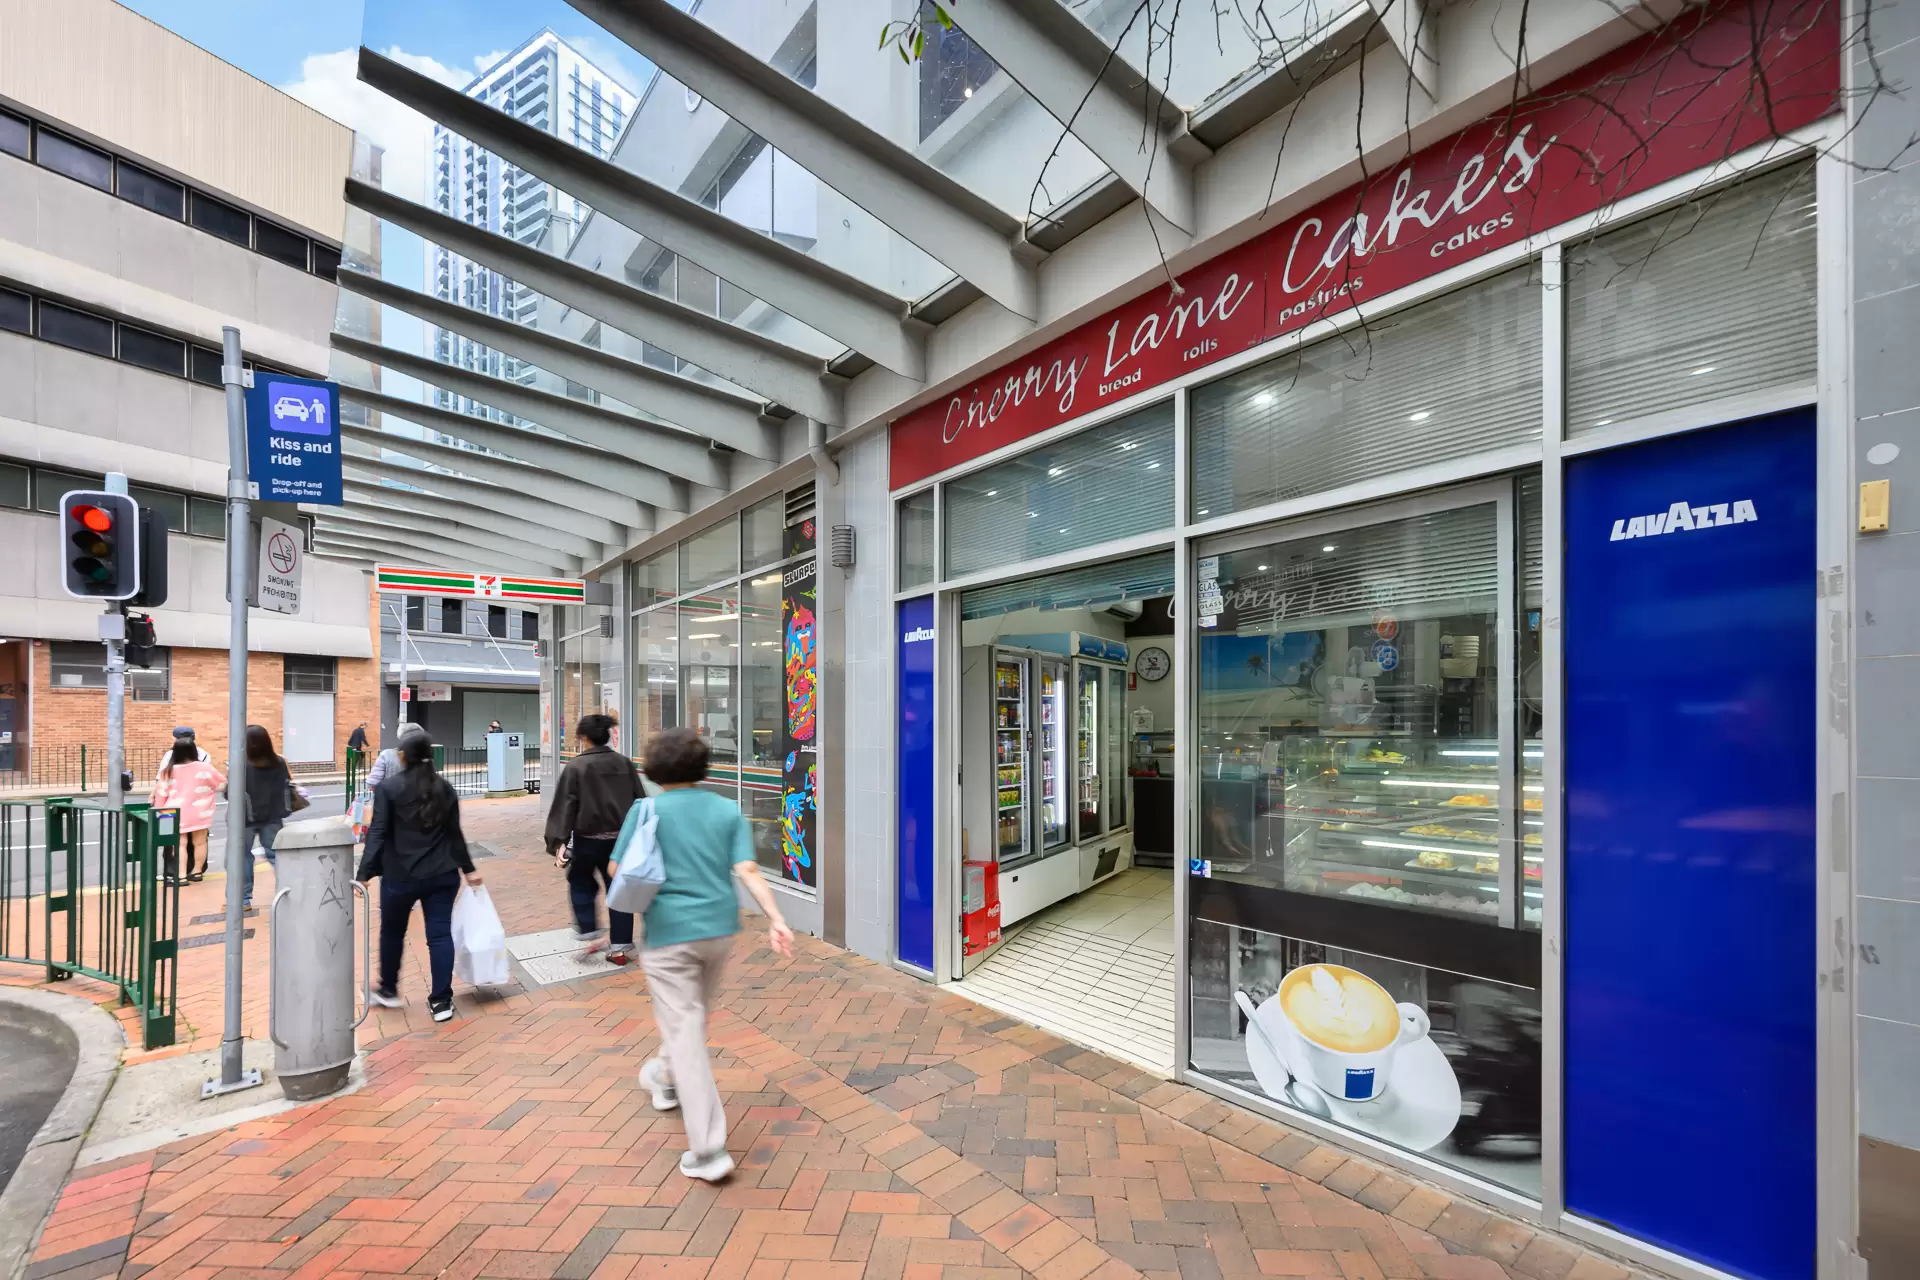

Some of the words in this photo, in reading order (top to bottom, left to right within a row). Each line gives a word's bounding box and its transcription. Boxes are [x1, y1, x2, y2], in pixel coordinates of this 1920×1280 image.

[942, 353, 1088, 444] Cherry
[1103, 272, 1253, 377] Lane
[1282, 123, 1557, 294] Cakes
[1099, 367, 1142, 397] bread
[1183, 337, 1218, 362] rolls
[1278, 274, 1364, 325] pastries
[1429, 210, 1515, 258] cakes
[269, 436, 301, 451] Kiss
[303, 442, 332, 454] and
[270, 453, 302, 467] ride
[271, 478, 307, 487] Drop-off
[272, 486, 303, 496] pick-up
[303, 488, 322, 497] here
[1609, 499, 1758, 542] LAVAZZA
